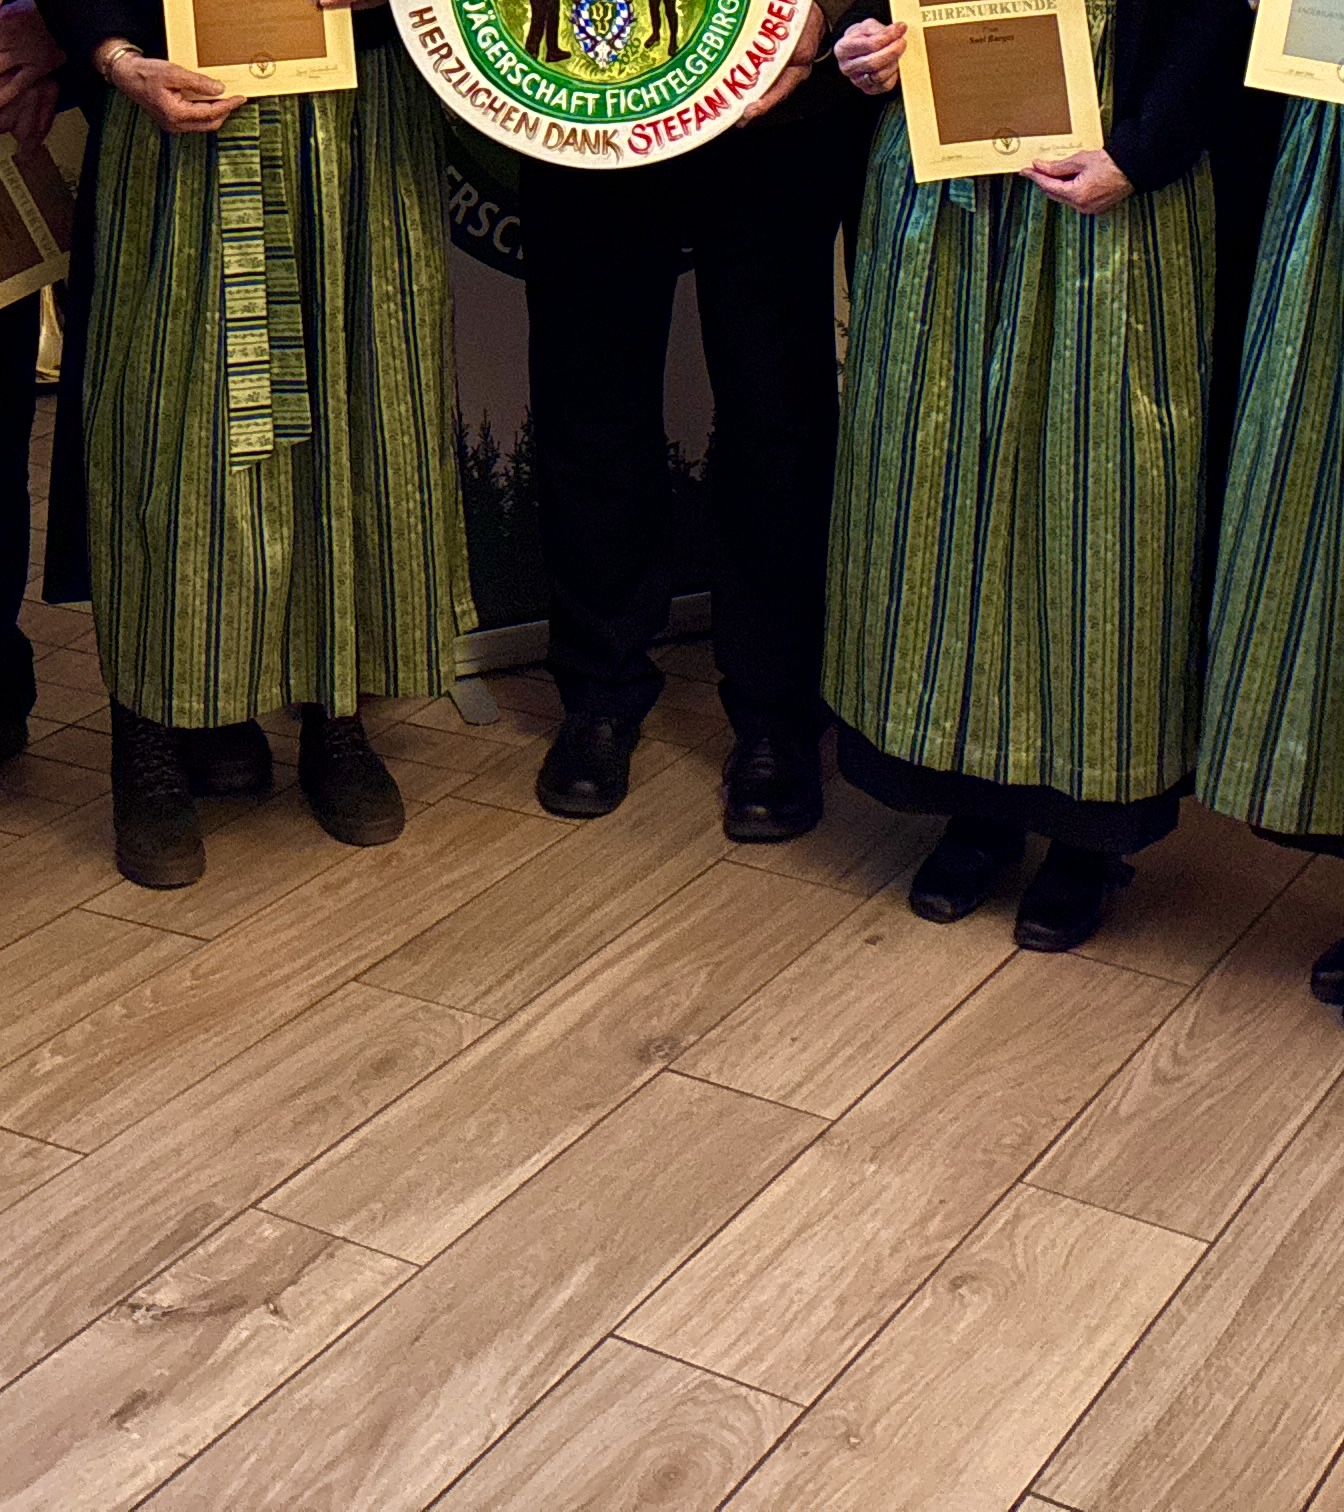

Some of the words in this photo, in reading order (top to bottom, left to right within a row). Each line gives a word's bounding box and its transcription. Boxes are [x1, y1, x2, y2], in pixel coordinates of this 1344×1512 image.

[408, 5, 541, 140] HERZLICHEN
[541, 122, 624, 164] DANK
[628, 88, 732, 155] STEFAN
[462, 0, 600, 116] JÄGERSCHAFT
